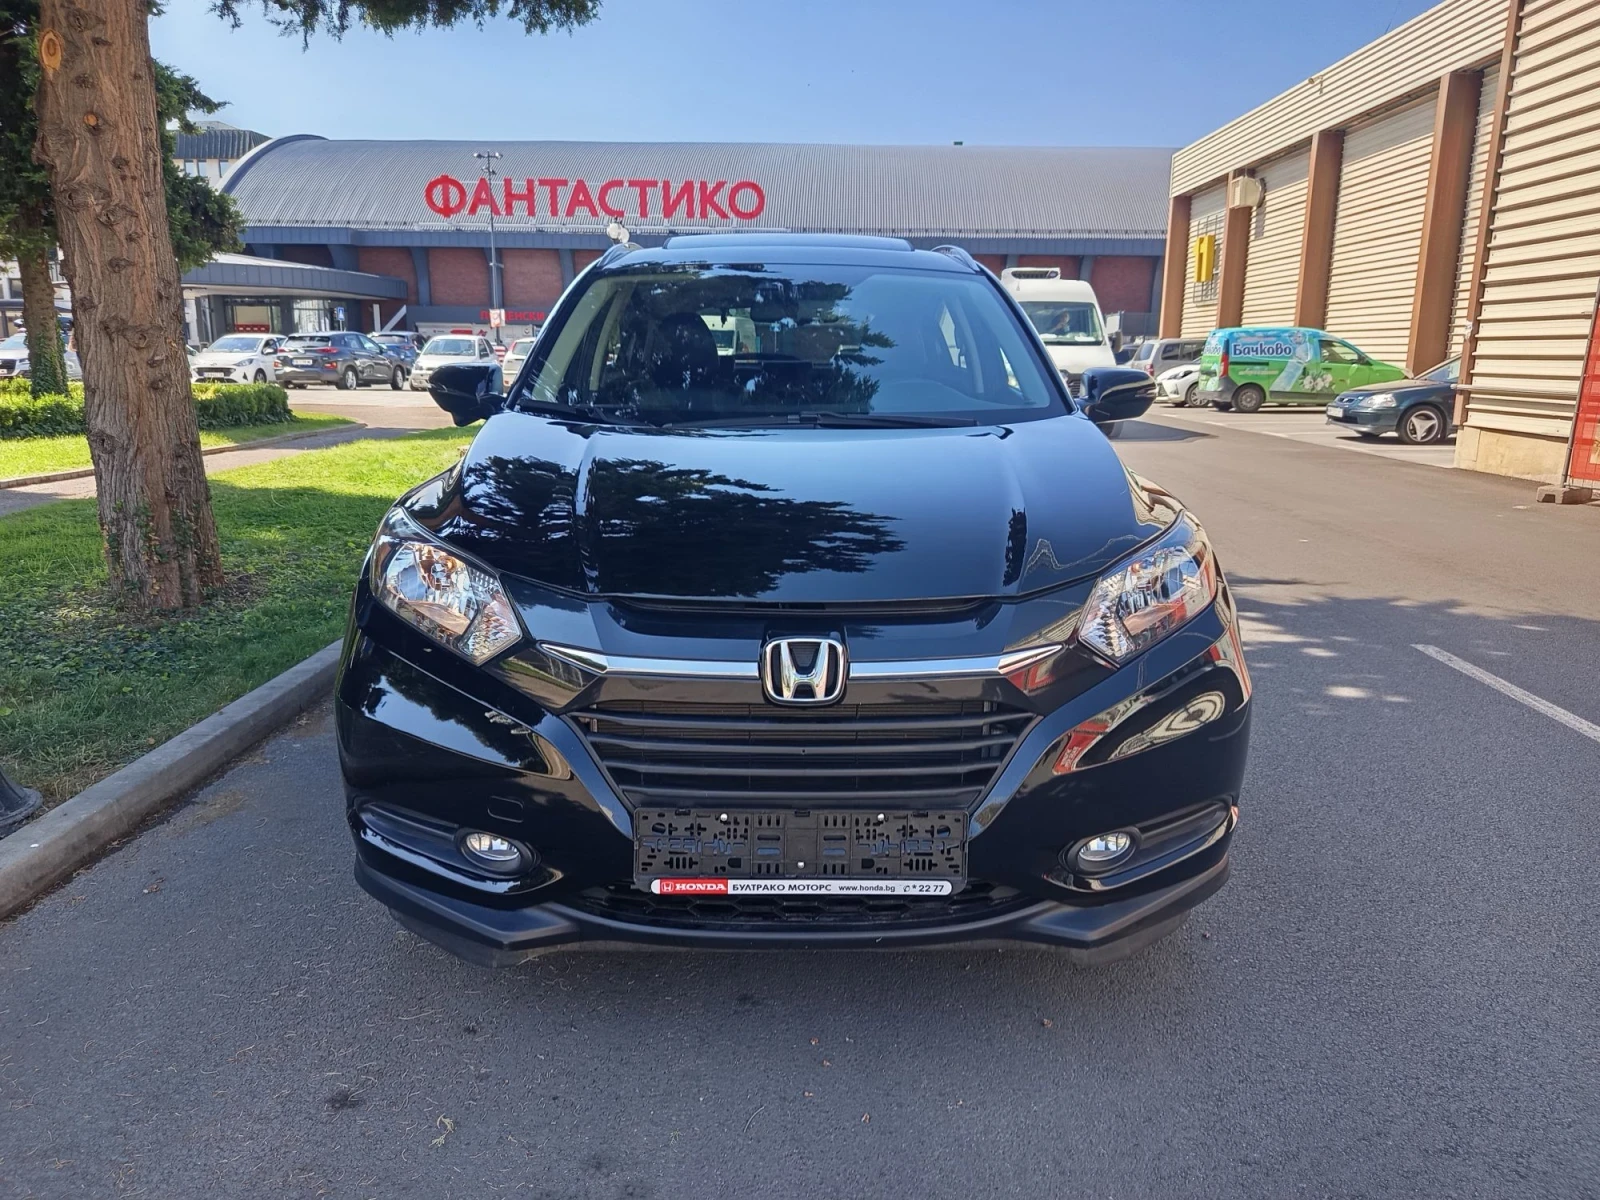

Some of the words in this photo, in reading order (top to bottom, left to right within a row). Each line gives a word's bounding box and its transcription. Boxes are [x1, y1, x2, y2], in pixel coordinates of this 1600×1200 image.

[424, 174, 765, 220] ФАНТАСТИКО
[1232, 341, 1292, 356] Бачково
[675, 883, 727, 891] HONDA
[838, 884, 896, 893] www.honda.bg
